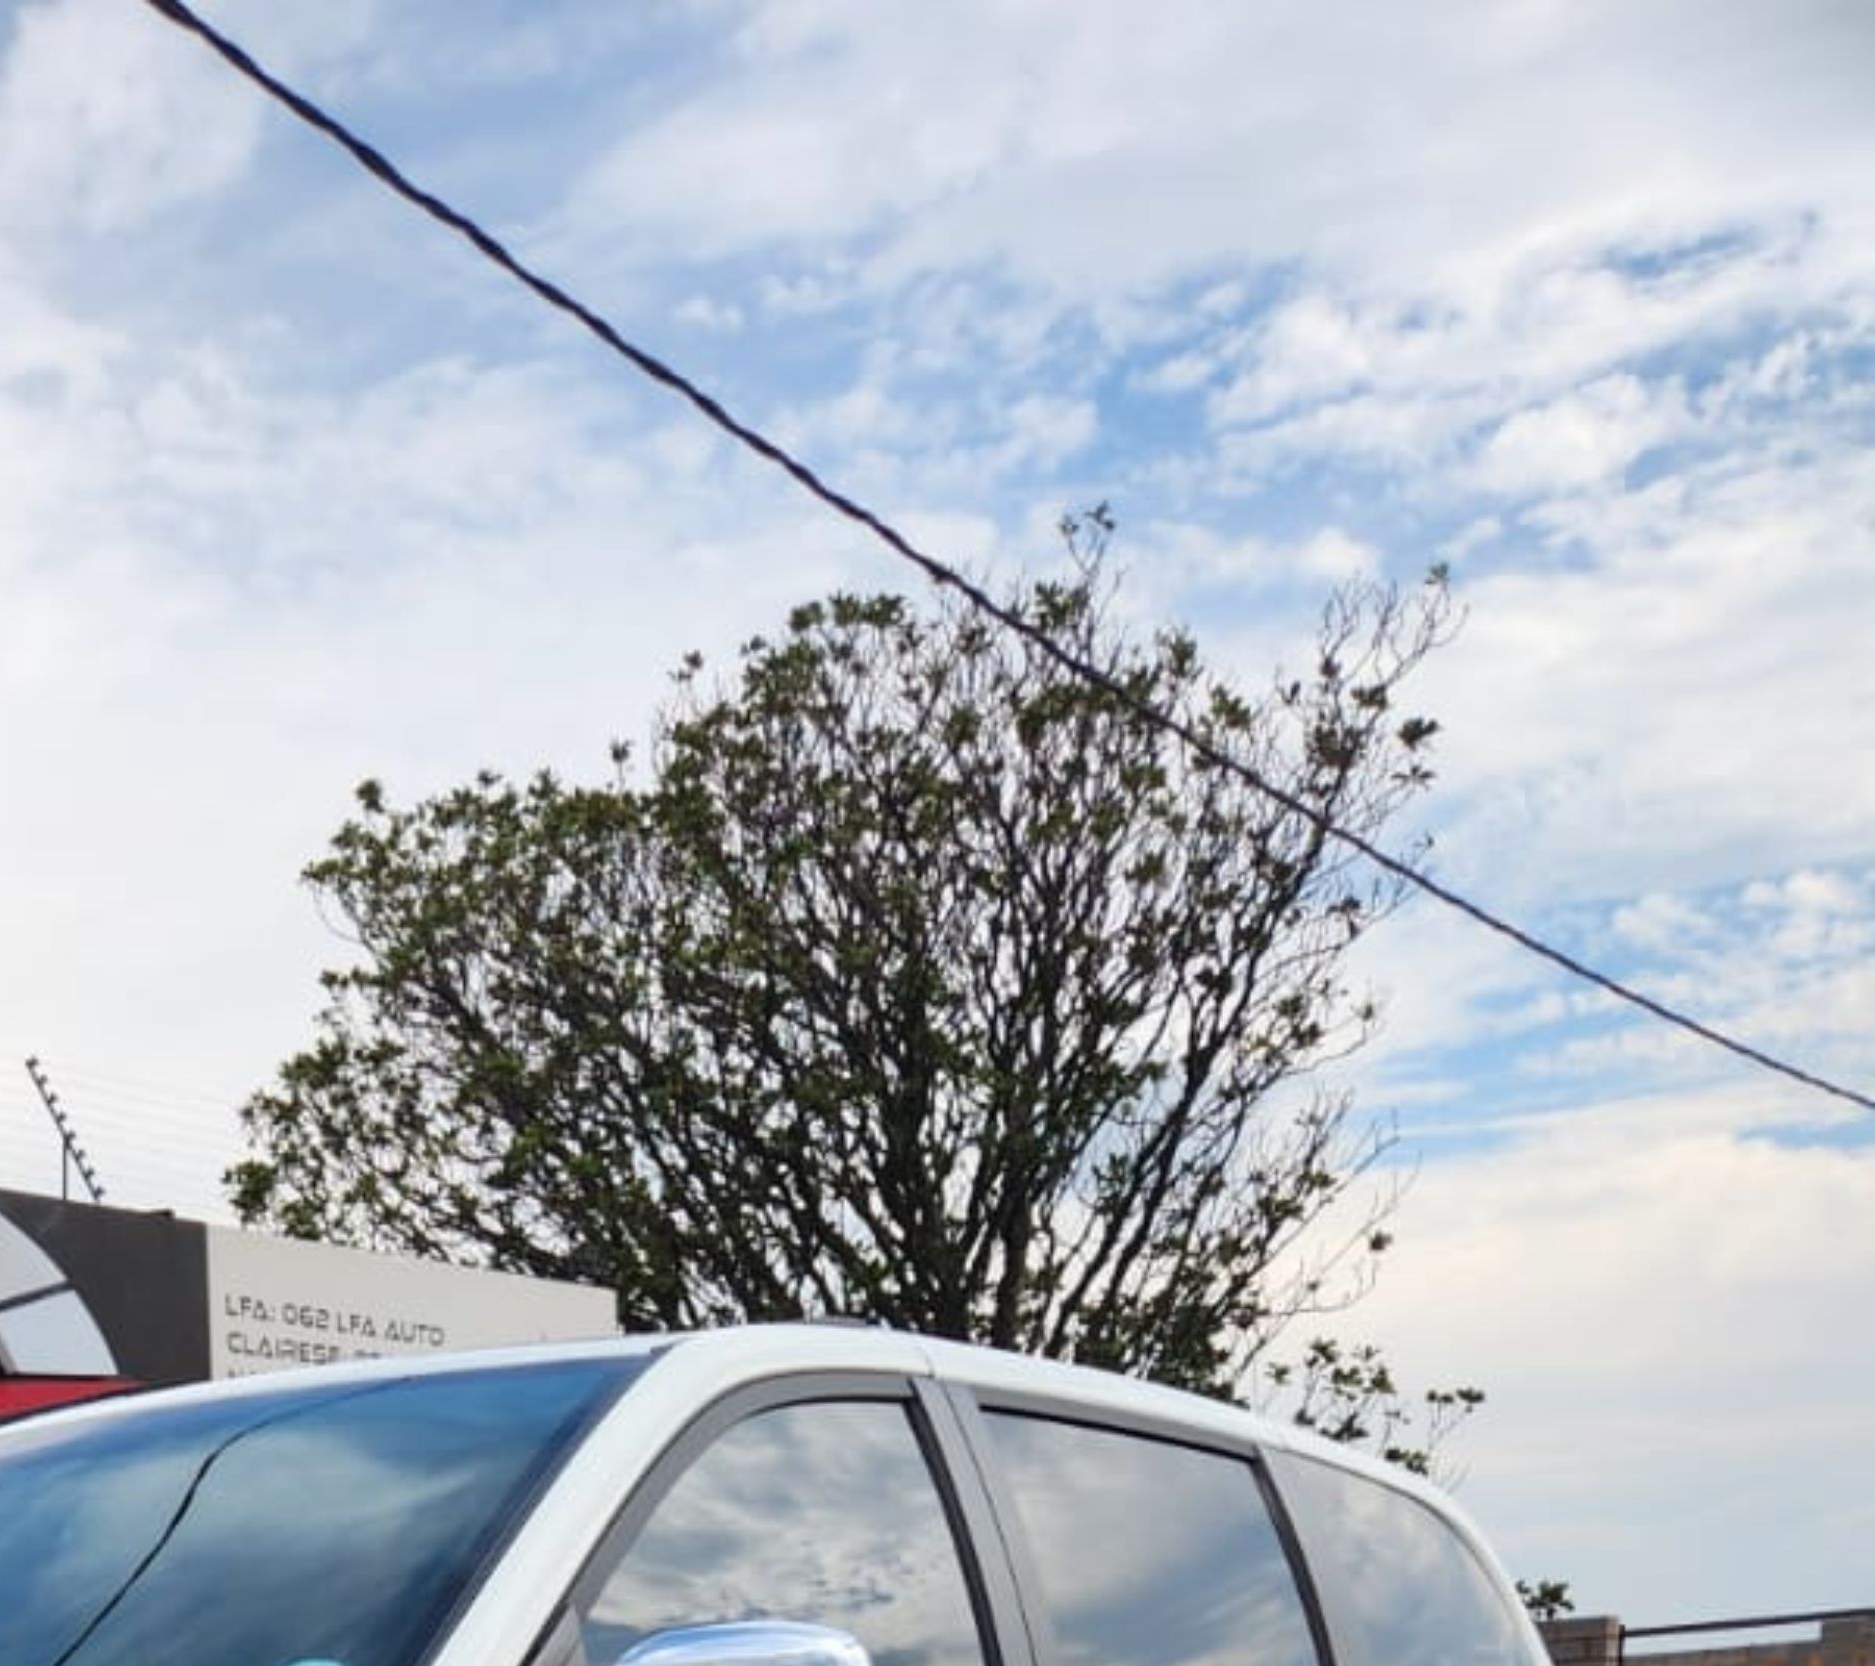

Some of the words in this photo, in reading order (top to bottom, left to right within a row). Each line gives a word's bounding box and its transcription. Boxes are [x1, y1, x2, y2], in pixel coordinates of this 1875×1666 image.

[281, 1302, 330, 1330] 062
[336, 1313, 377, 1338] LFA
[384, 1320, 445, 1348] AUTO
